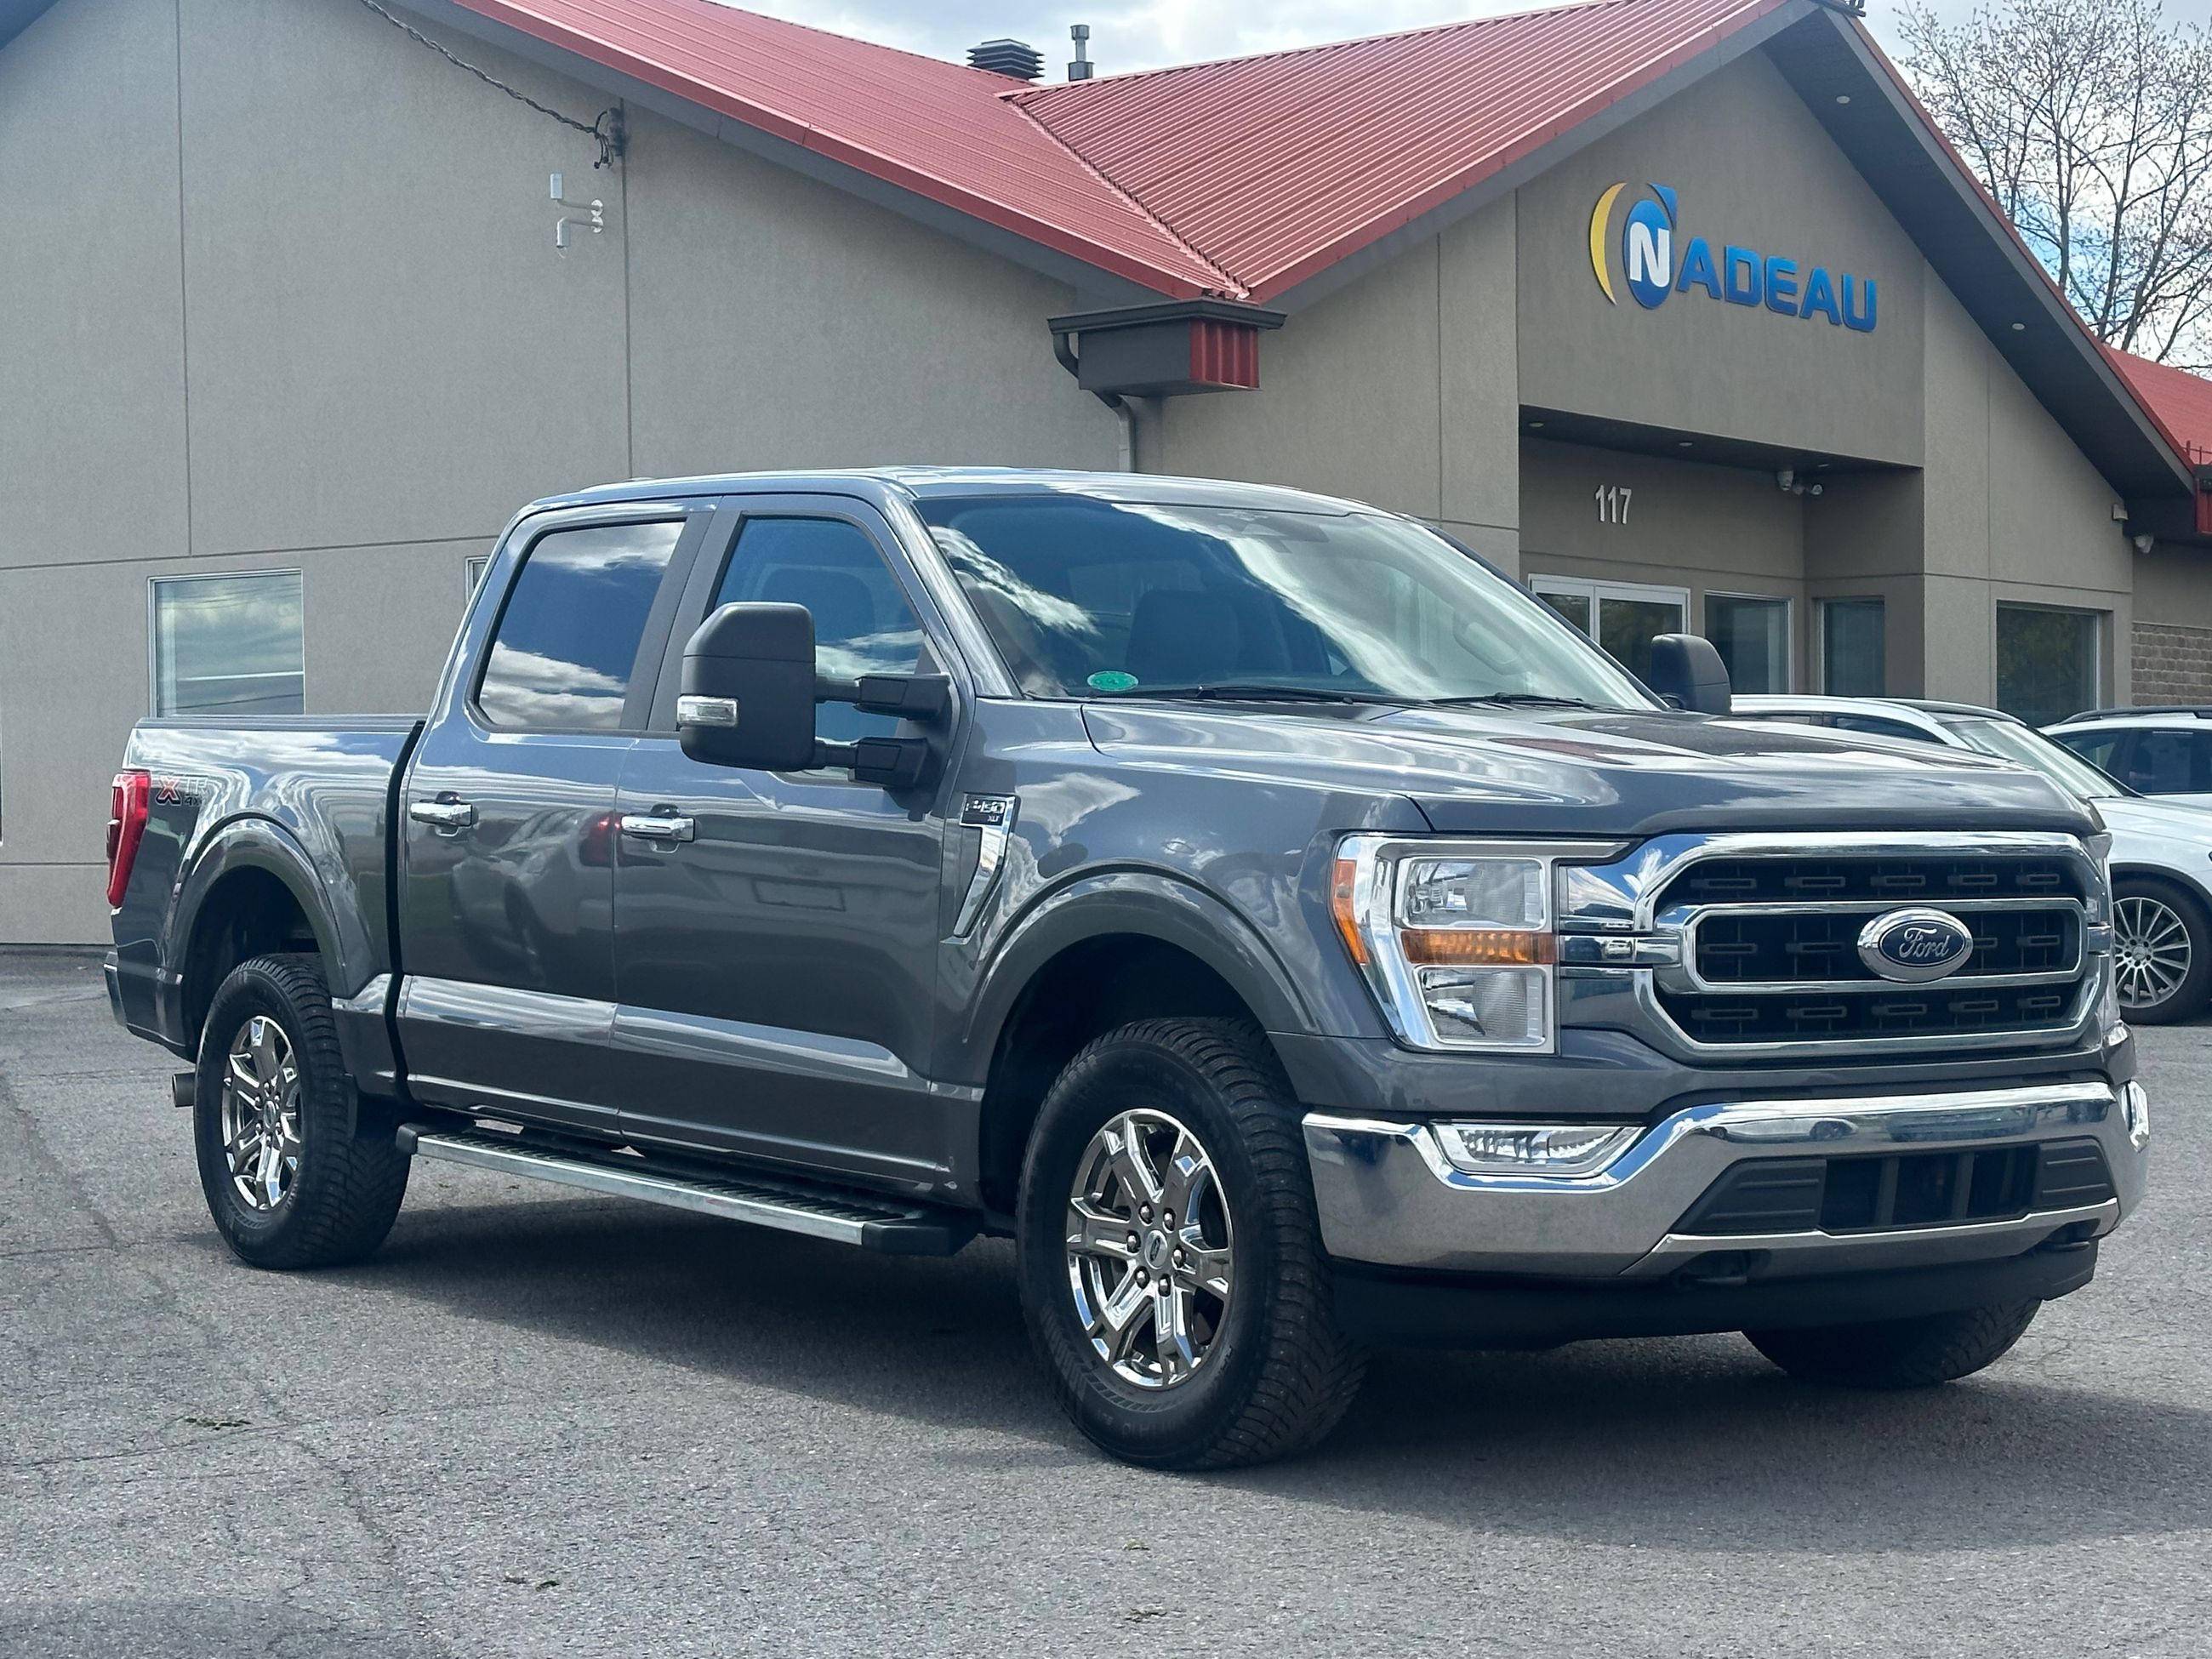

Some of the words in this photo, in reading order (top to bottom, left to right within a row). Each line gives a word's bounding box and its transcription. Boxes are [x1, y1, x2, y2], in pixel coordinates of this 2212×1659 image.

[1628, 221, 1878, 333] NADEAU
[1594, 483, 1633, 525] 117
[1898, 926, 1951, 959] Ford
